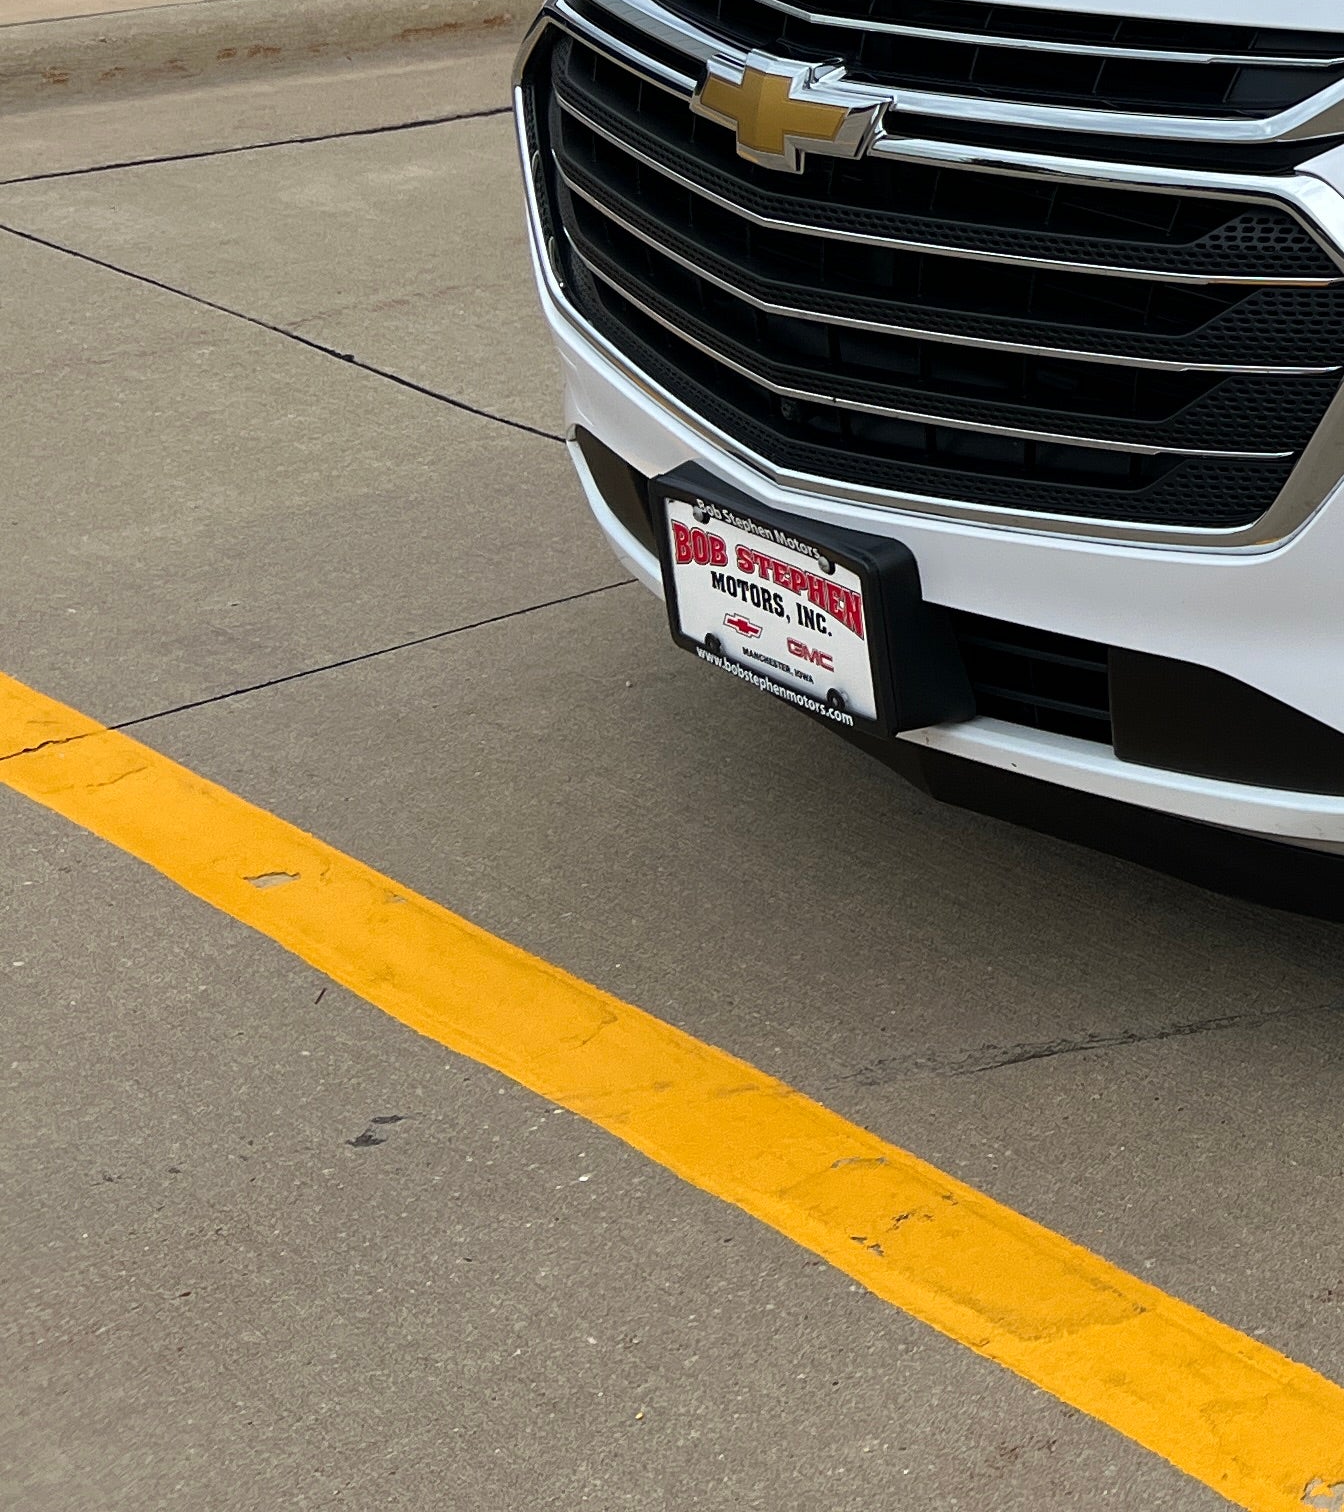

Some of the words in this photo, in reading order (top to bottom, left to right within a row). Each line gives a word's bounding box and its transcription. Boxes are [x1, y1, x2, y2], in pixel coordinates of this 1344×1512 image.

[696, 498, 722, 520] Bob
[722, 509, 774, 541] Stephen
[773, 529, 820, 559] Motors
[671, 520, 729, 566] BOB
[735, 544, 865, 640] STEPHEN
[710, 571, 791, 624] MOTORS,
[796, 602, 833, 637] INC.
[696, 646, 854, 727] www.bobstephenmotors.com
[787, 637, 835, 672] GMC
